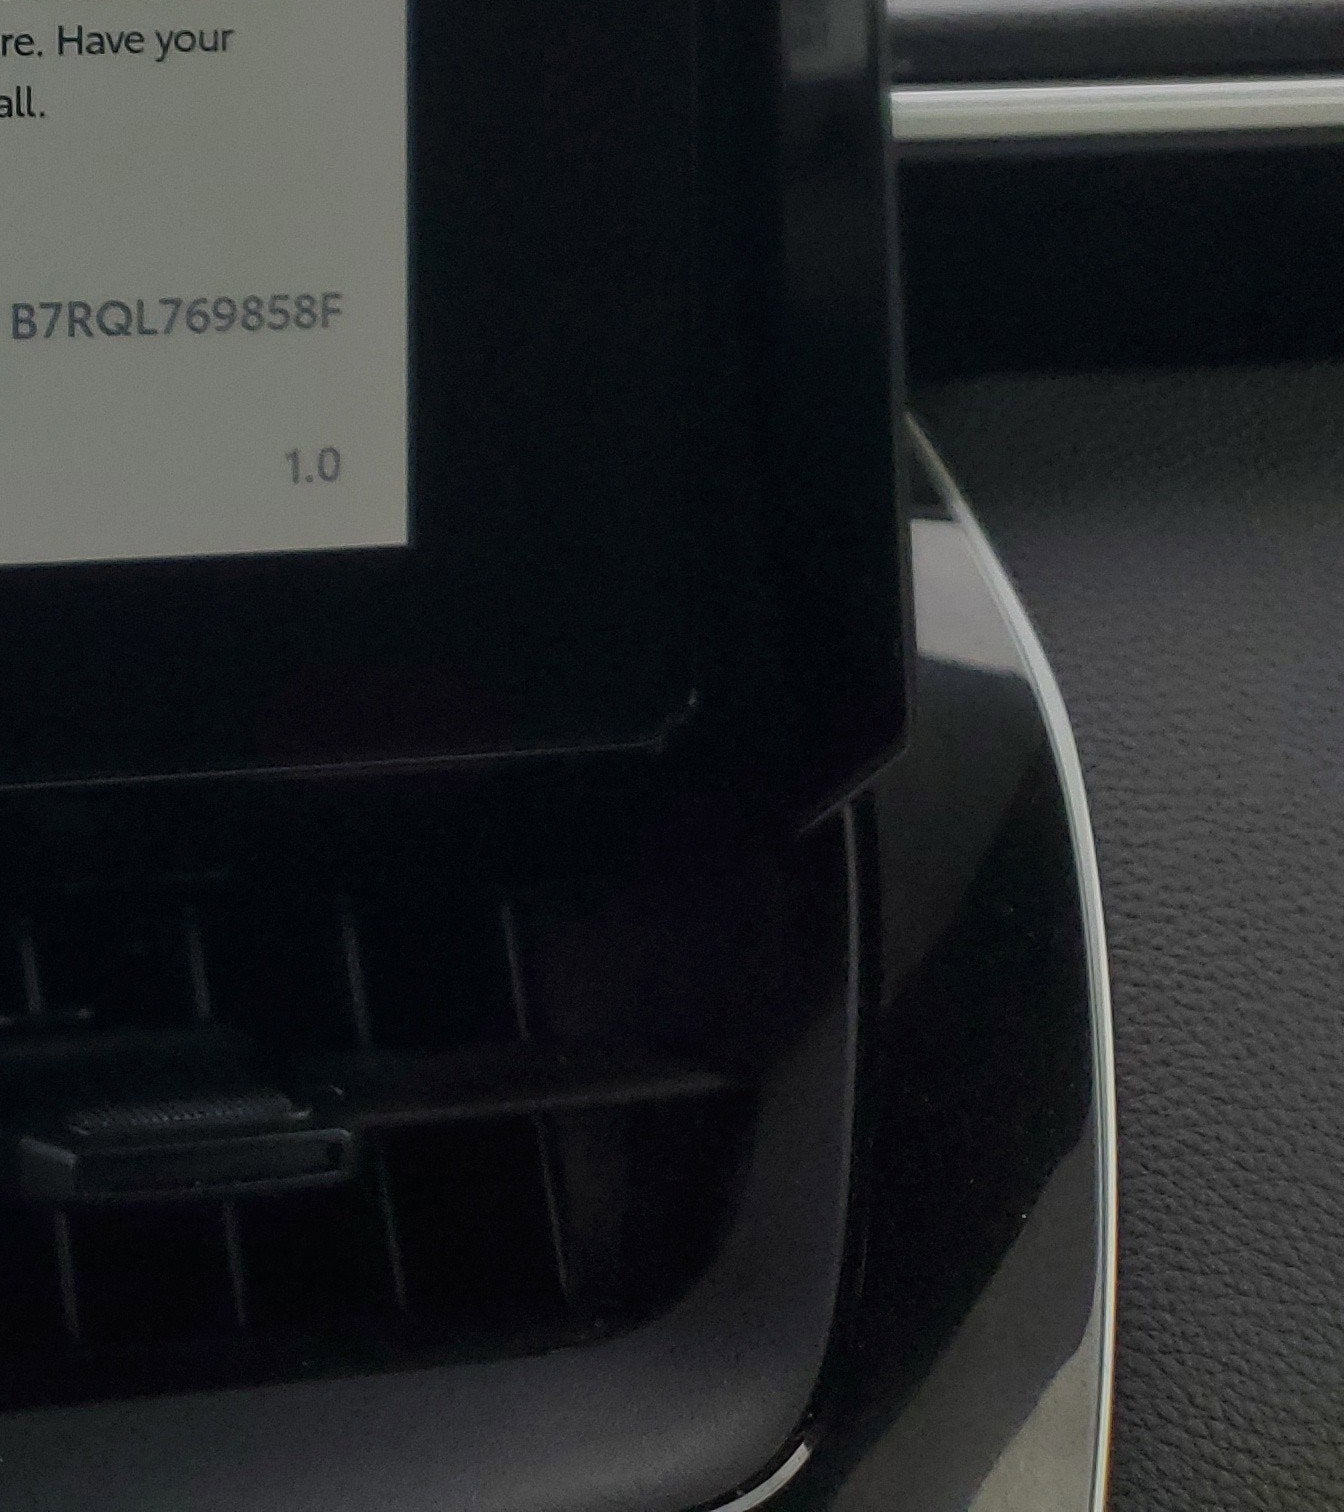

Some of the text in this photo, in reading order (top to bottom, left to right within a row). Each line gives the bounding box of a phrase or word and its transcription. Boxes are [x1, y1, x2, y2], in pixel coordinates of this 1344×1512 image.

[58, 25, 145, 55] Have
[155, 30, 235, 63] your
[12, 293, 341, 340] B7RQL769858F
[286, 446, 341, 484] 1.0
